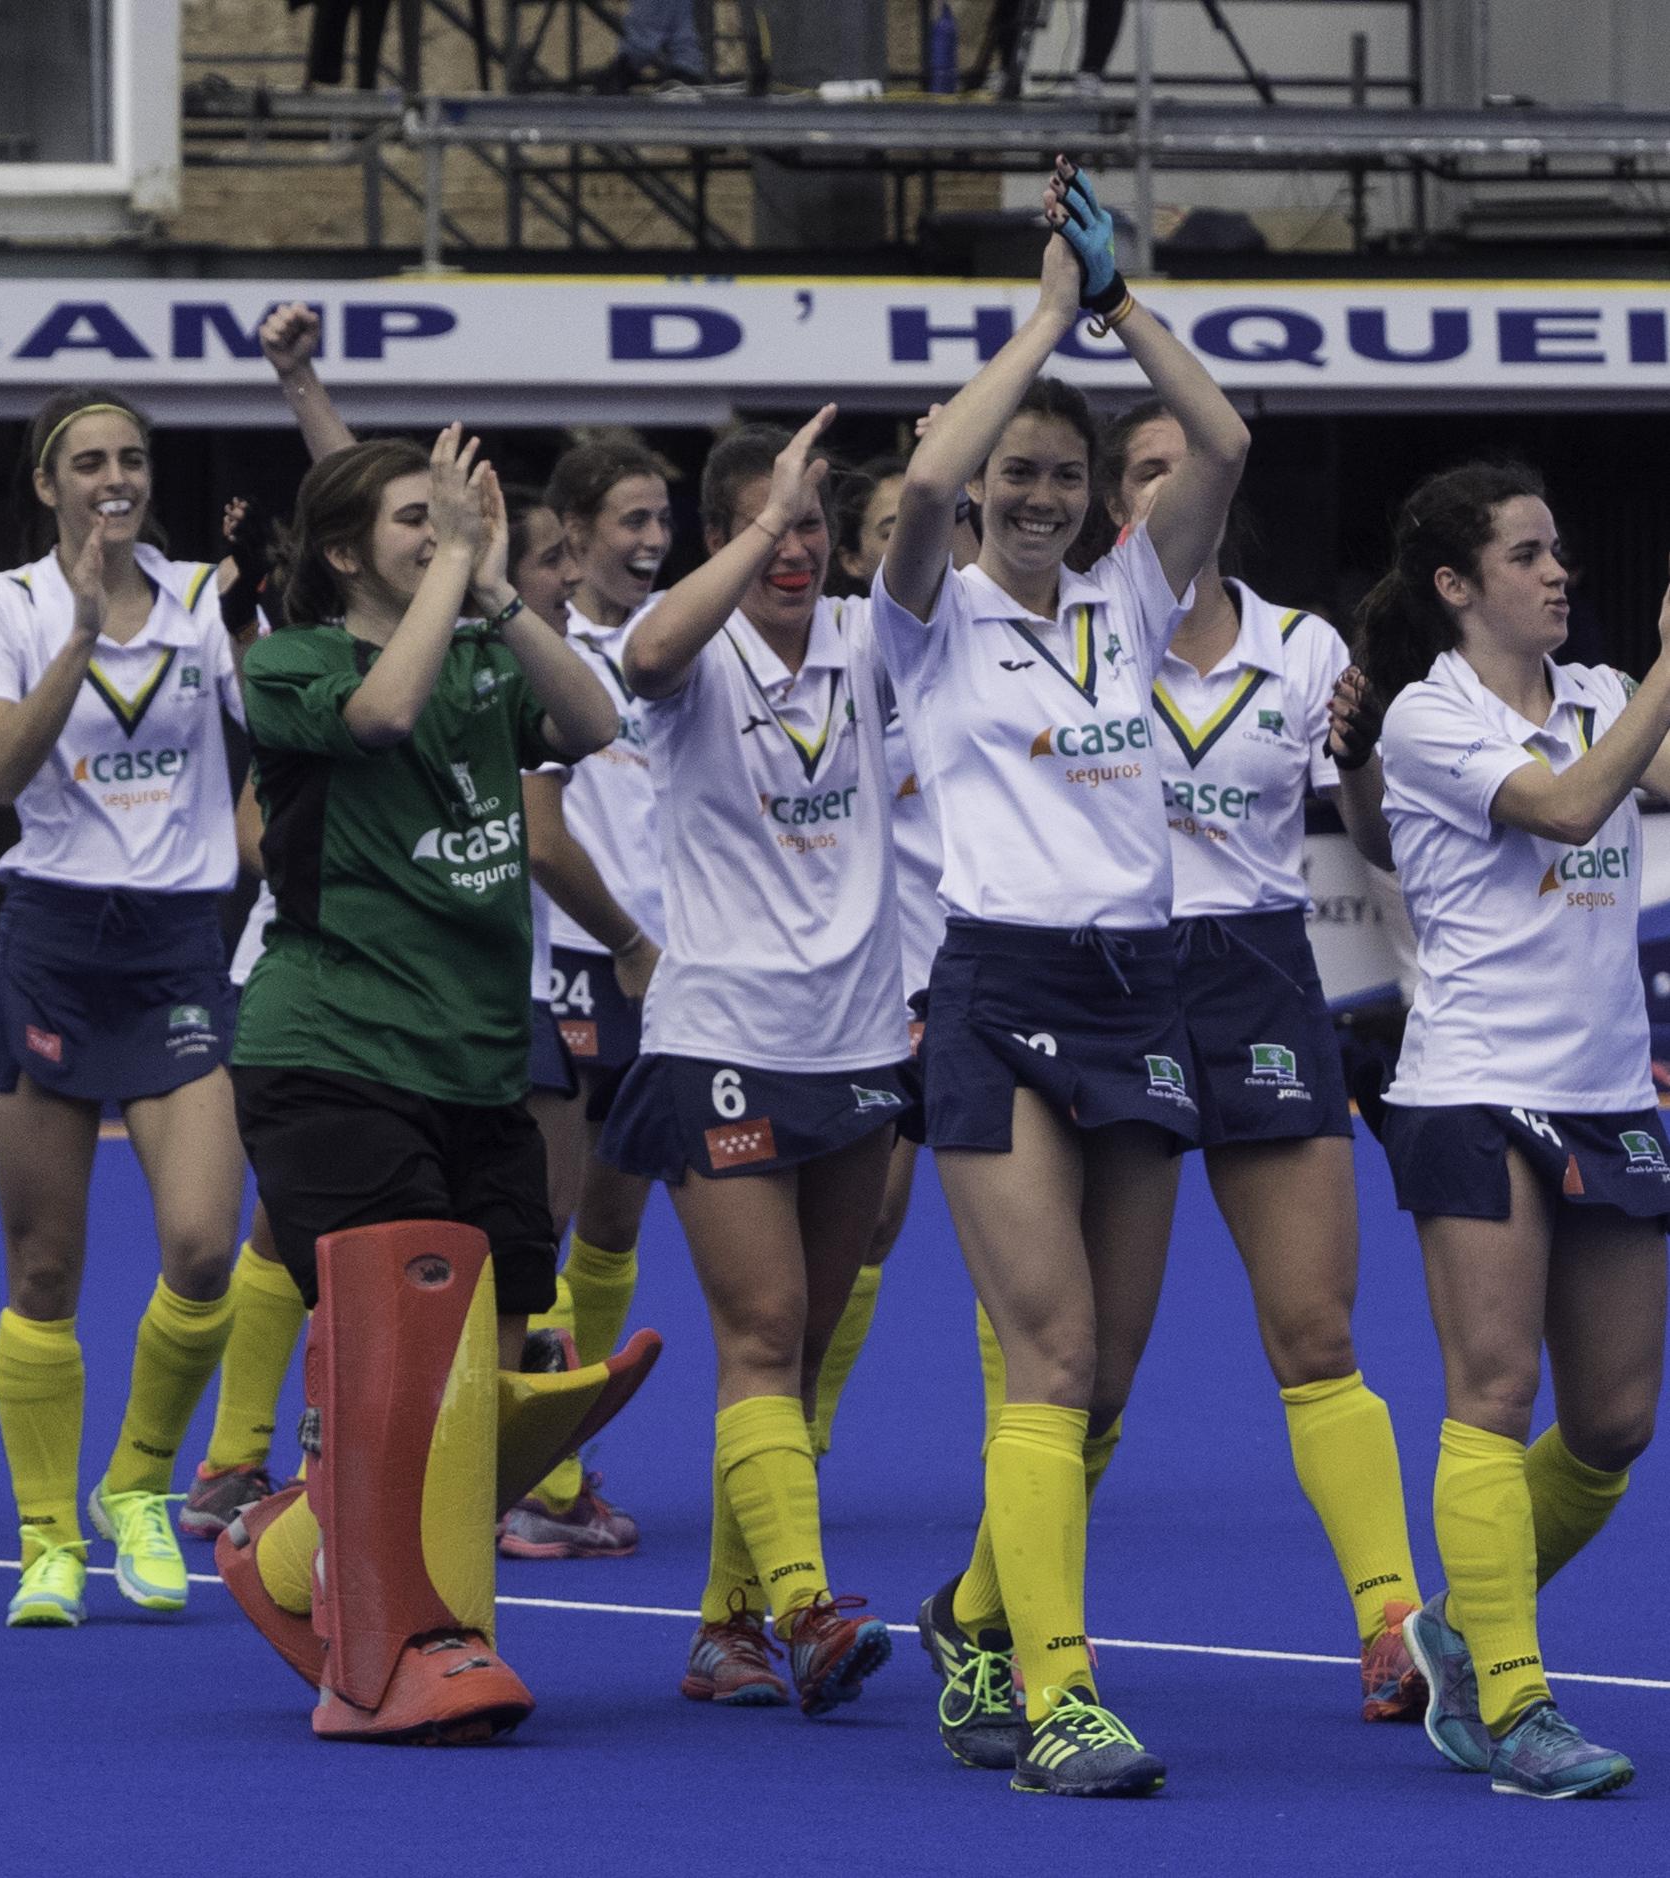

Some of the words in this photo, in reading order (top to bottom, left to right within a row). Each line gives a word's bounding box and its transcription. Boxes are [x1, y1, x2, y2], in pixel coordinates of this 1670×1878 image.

[1066, 762, 1142, 788] seguros
[101, 788, 171, 811] seguros
[770, 785, 858, 825] caser
[549, 967, 596, 1016] 24
[712, 1069, 747, 1119] 6
